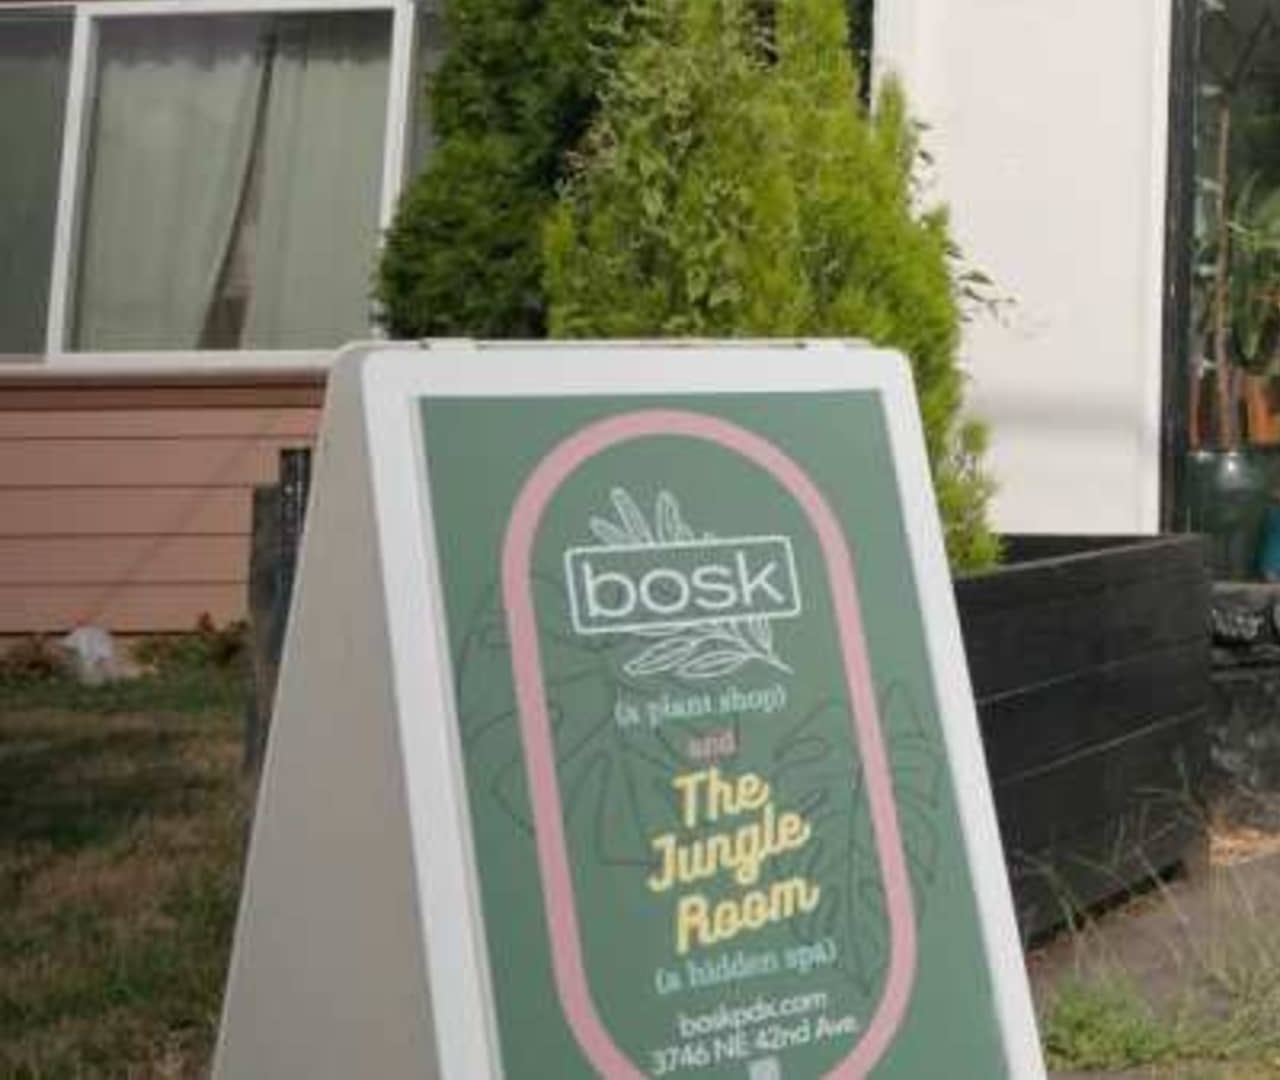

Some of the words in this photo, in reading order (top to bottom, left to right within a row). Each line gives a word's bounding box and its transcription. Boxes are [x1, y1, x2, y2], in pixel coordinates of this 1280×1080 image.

[581, 551, 784, 617] bosk
[672, 765, 769, 829] The
[647, 802, 811, 892] Jungle
[676, 877, 821, 956] Room
[650, 1042, 711, 1077] 3746
[714, 1034, 749, 1063] NE
[754, 1018, 810, 1051] 42nd
[677, 992, 827, 1039] boskpdx.com
